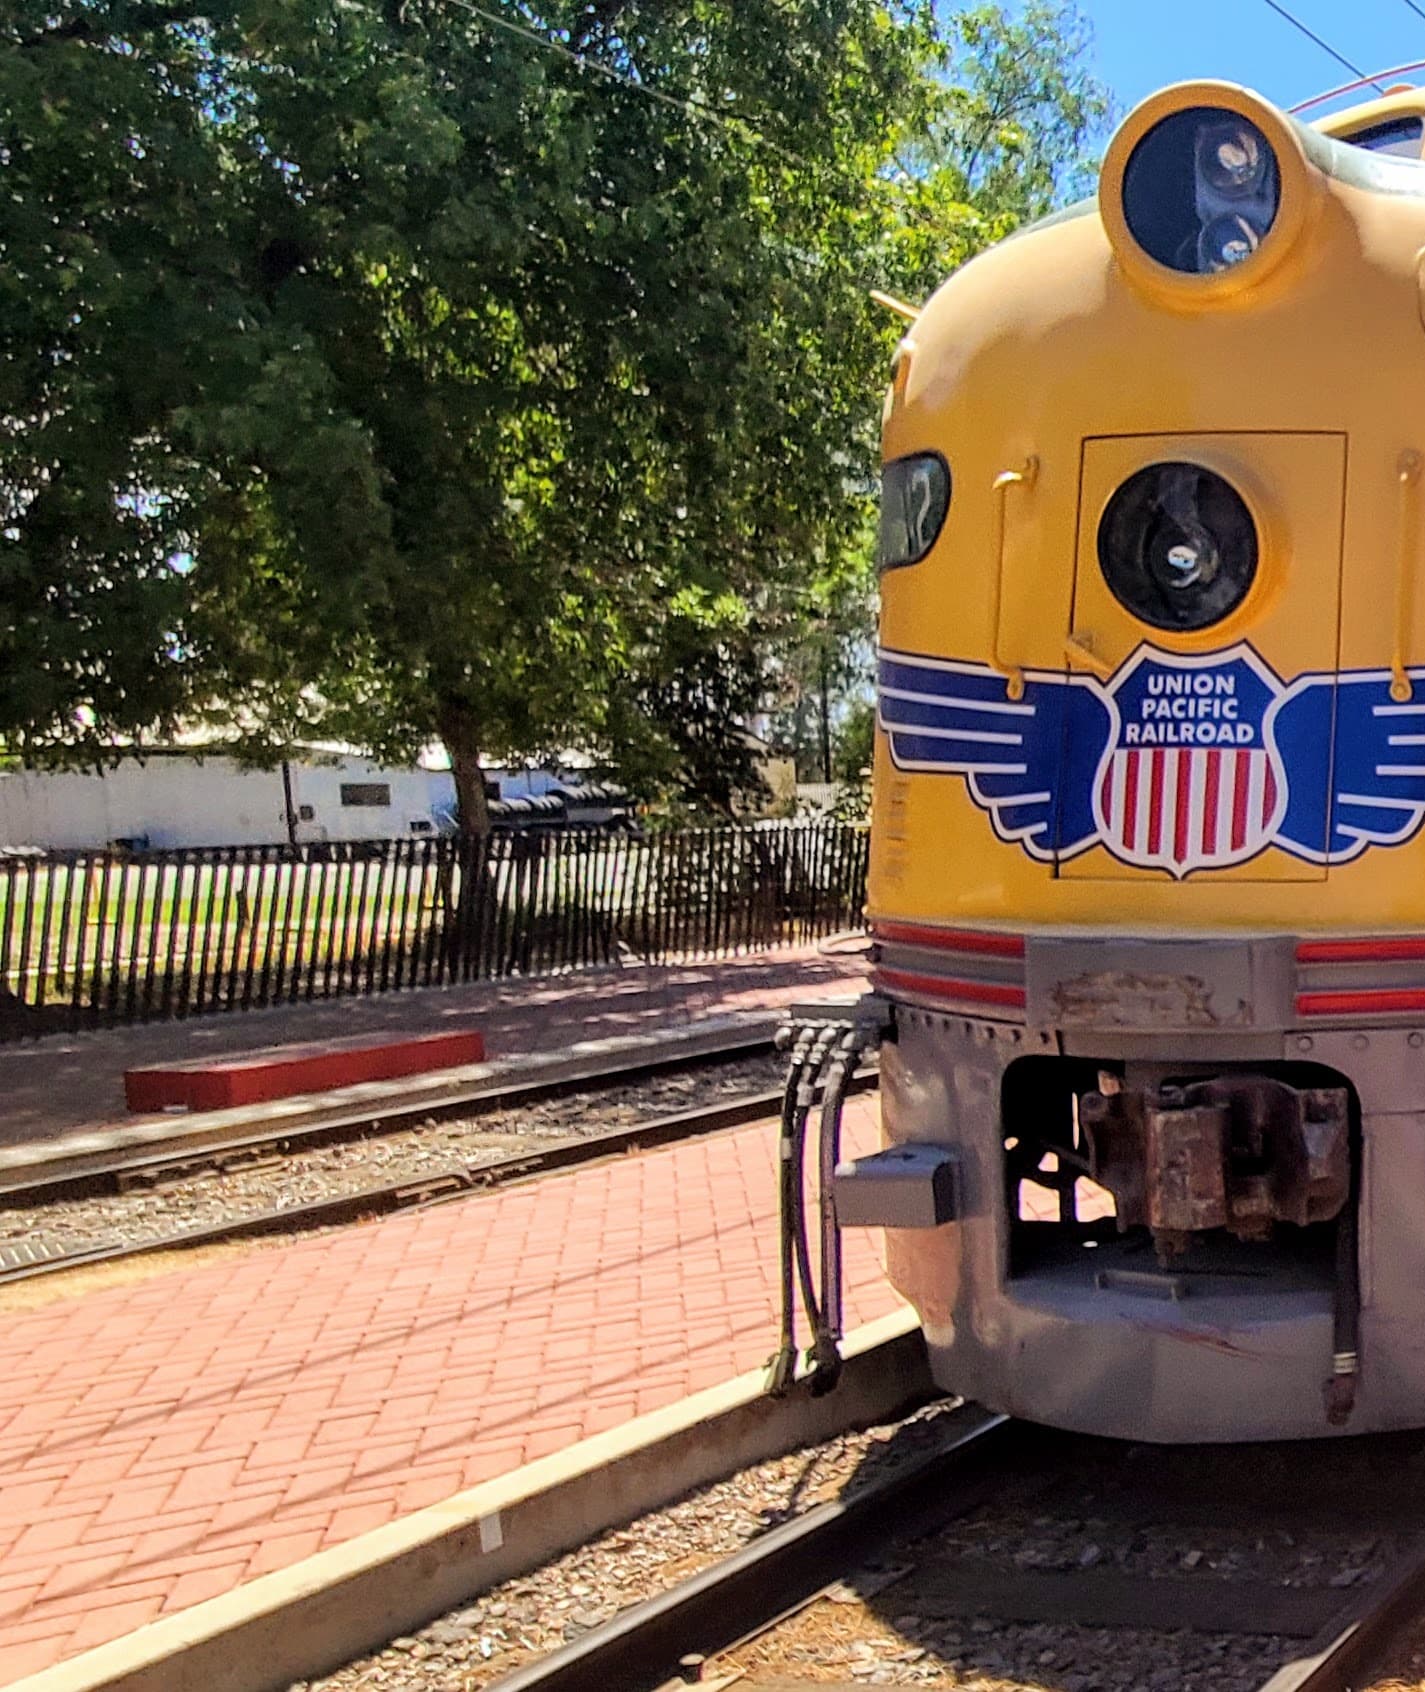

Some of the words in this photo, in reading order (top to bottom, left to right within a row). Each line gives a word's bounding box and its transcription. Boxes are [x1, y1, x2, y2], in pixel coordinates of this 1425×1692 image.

[1147, 673, 1236, 696] UNION
[1141, 697, 1239, 720] PACIFIC
[1125, 722, 1255, 744] RAILROAD
